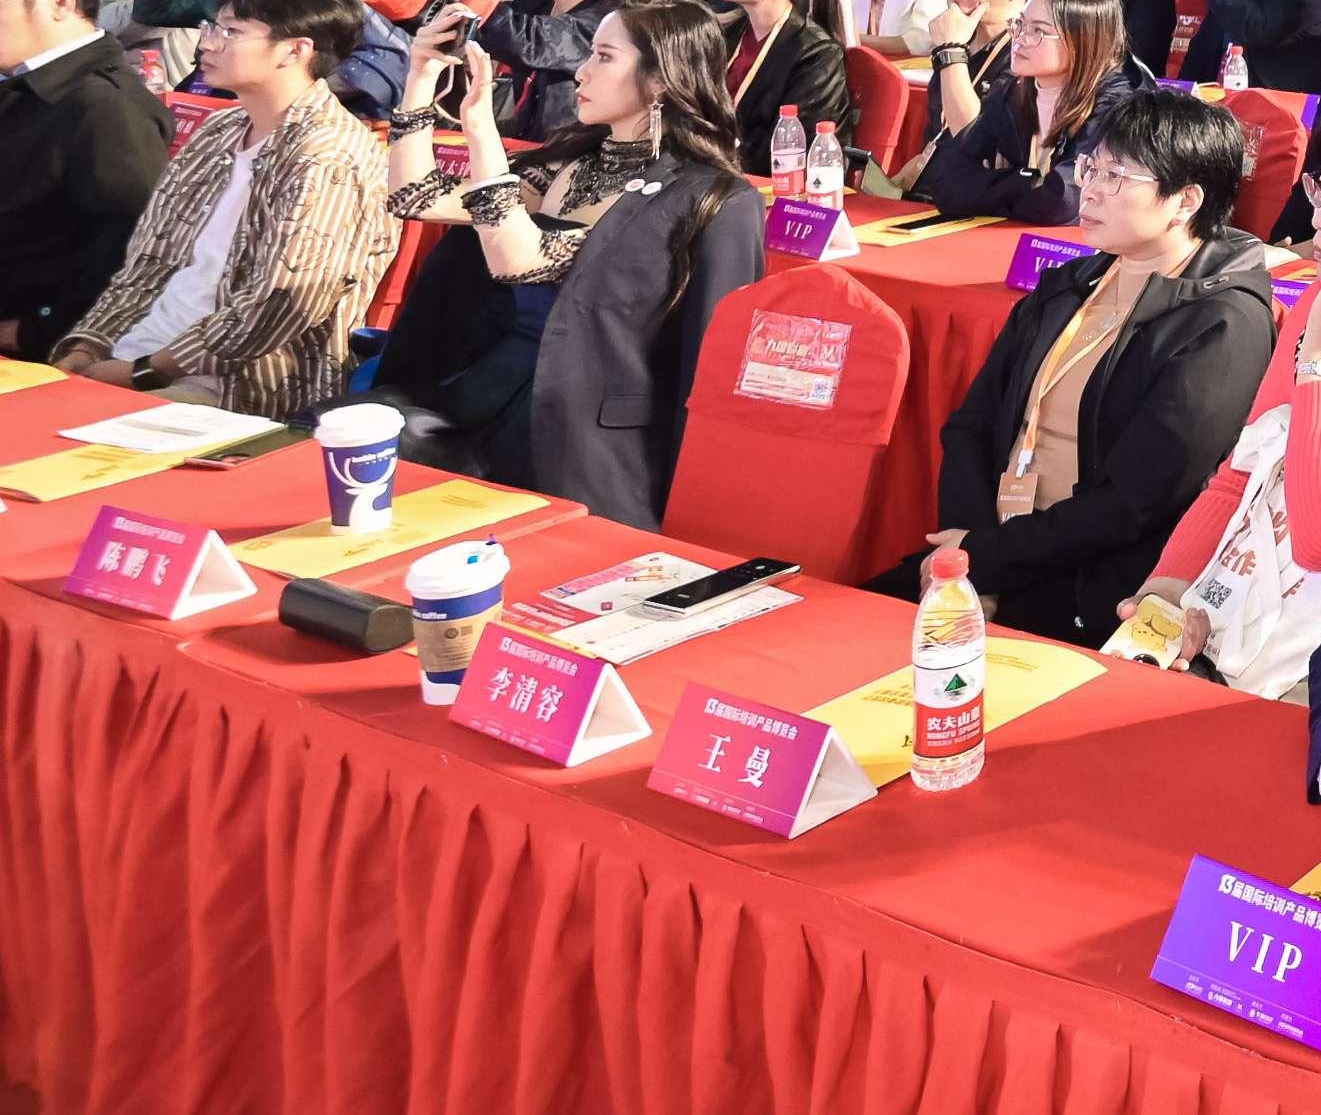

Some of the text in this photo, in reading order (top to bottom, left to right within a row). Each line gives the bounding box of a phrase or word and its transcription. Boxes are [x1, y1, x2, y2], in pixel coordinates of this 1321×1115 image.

[784, 220, 813, 239] VIP
[487, 666, 564, 723] 李清容
[1227, 920, 1304, 984] VIP
